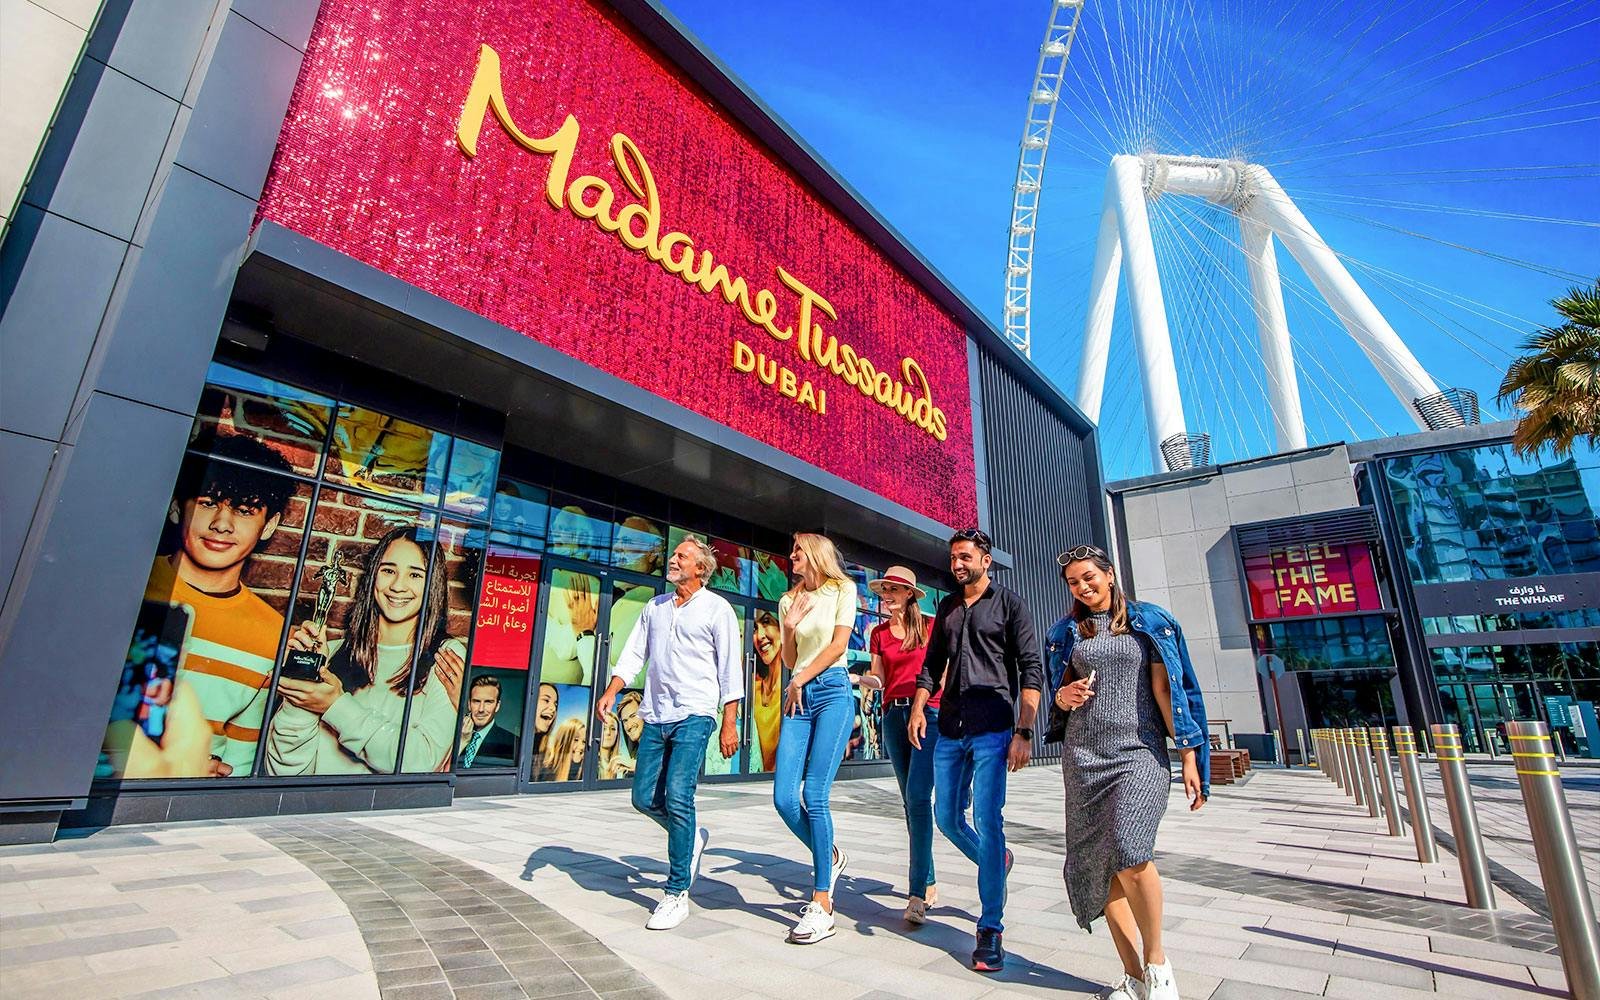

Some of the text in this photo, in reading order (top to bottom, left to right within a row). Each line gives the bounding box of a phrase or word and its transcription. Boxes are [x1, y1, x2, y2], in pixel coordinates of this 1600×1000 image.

[457, 43, 948, 442] Madame Tussauds
[734, 340, 828, 415] DUBAI
[1269, 543, 1341, 565] FEEL
[508, 564, 537, 583] تجربة
[1270, 564, 1328, 587] THE
[485, 580, 532, 597] للاستمتاع
[1275, 583, 1356, 609] FAME
[479, 596, 530, 615] أضواء الش
[1495, 594, 1565, 606] THE WHARF
[476, 614, 527, 634] وعالم الفن
